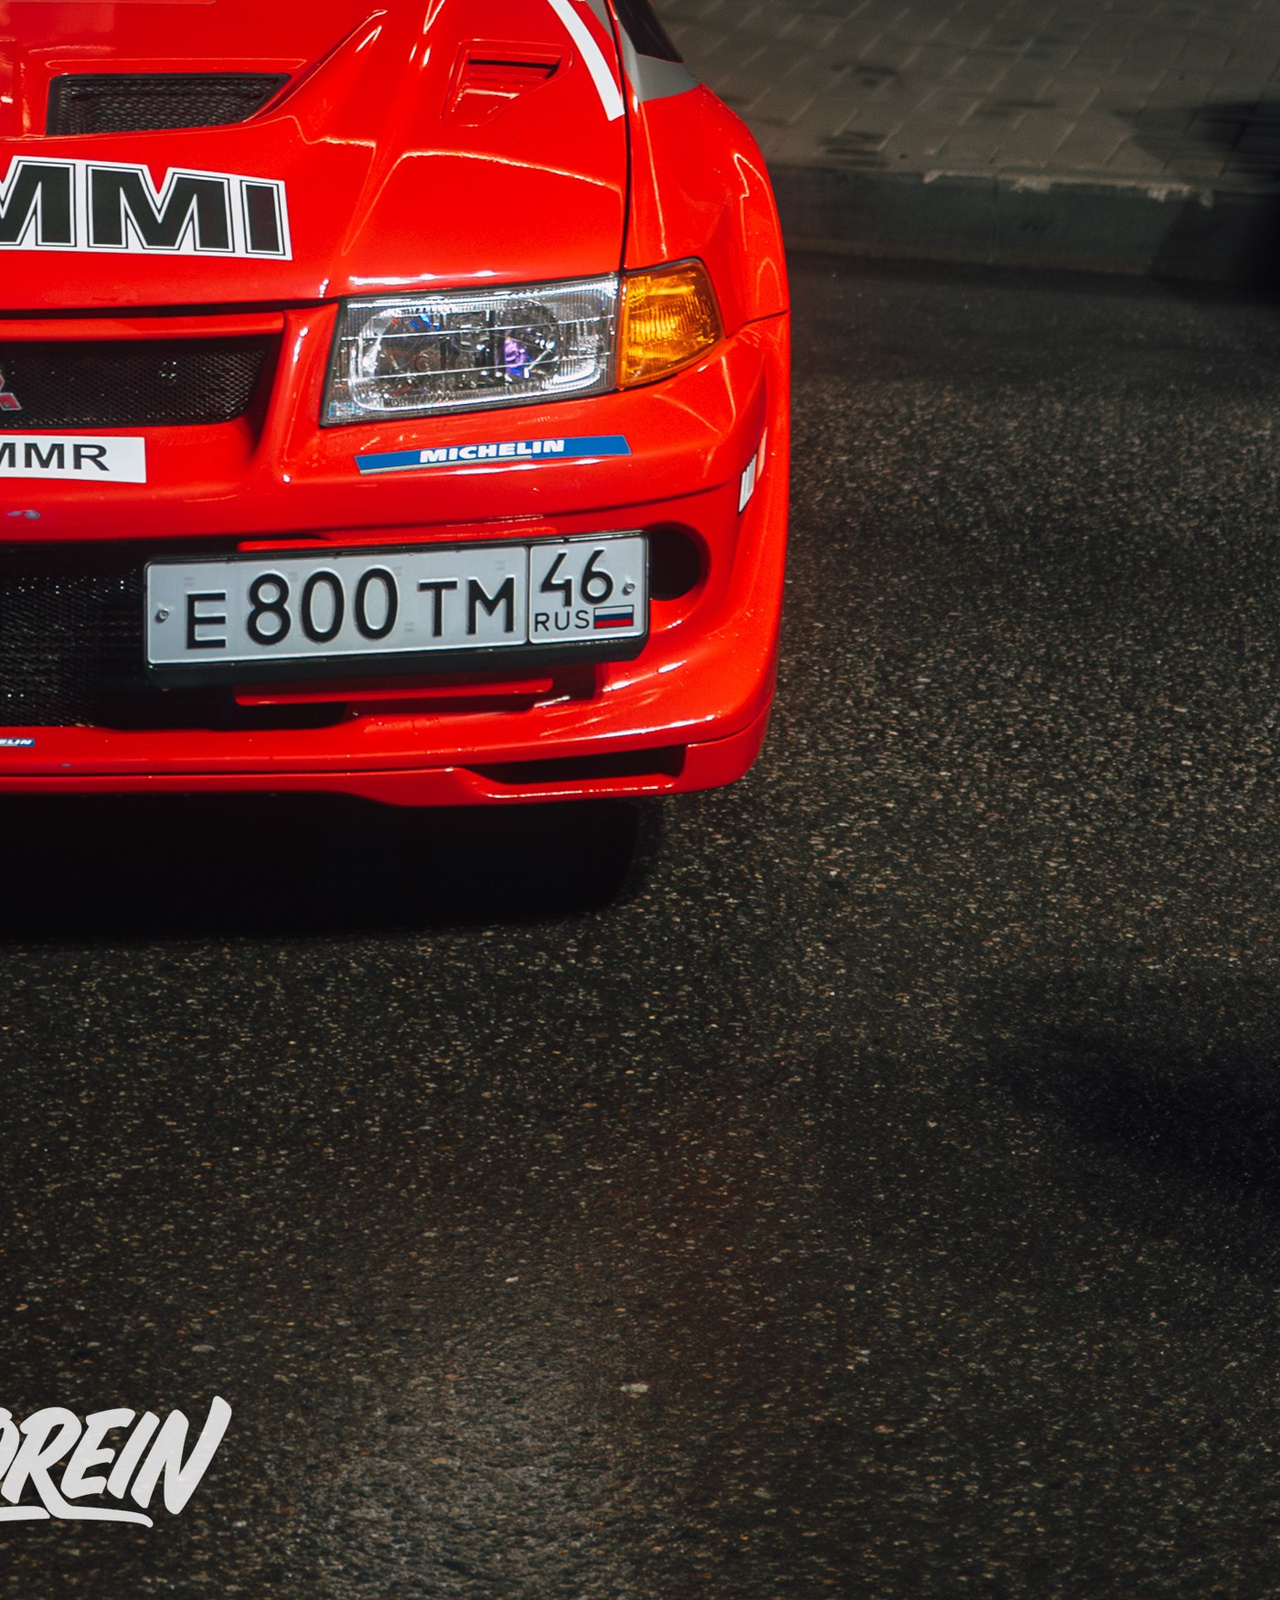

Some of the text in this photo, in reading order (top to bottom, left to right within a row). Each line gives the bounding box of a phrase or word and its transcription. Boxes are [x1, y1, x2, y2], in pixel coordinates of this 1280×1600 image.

[419, 439, 565, 463] MICHELIN
[540, 548, 614, 607] 46
[534, 611, 590, 633] RUS
